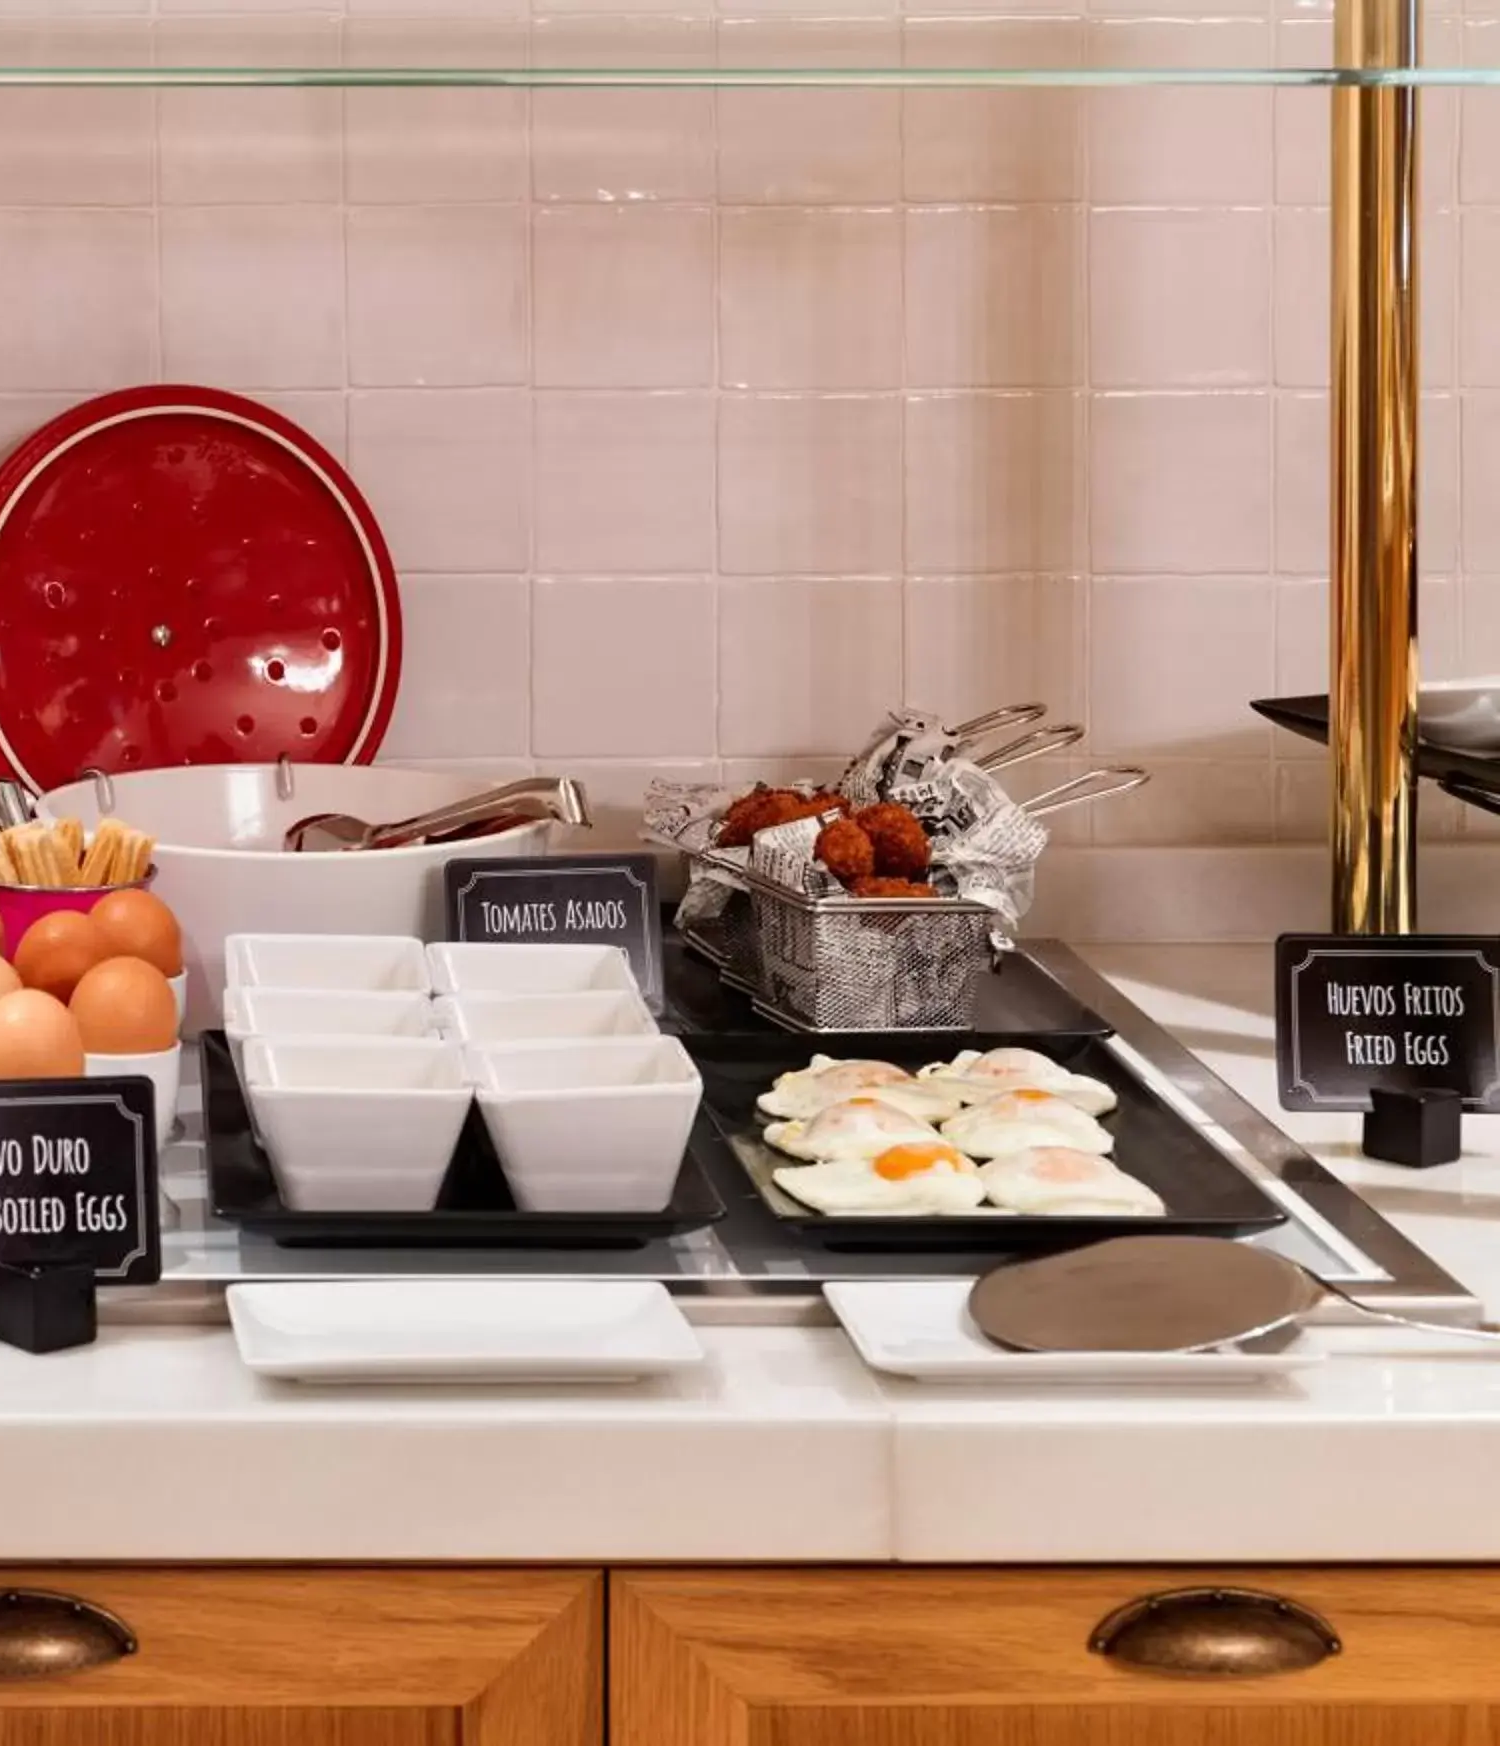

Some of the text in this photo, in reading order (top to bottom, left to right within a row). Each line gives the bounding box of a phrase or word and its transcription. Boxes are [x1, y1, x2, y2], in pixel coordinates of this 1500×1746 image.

[480, 898, 628, 935] TOMATES ASADOS
[1326, 981, 1465, 1018] HUEVOS FRITOS
[1344, 1030, 1450, 1067] FRIED EGGS
[31, 1133, 91, 1176] DURO
[74, 1190, 128, 1233] EGGS
